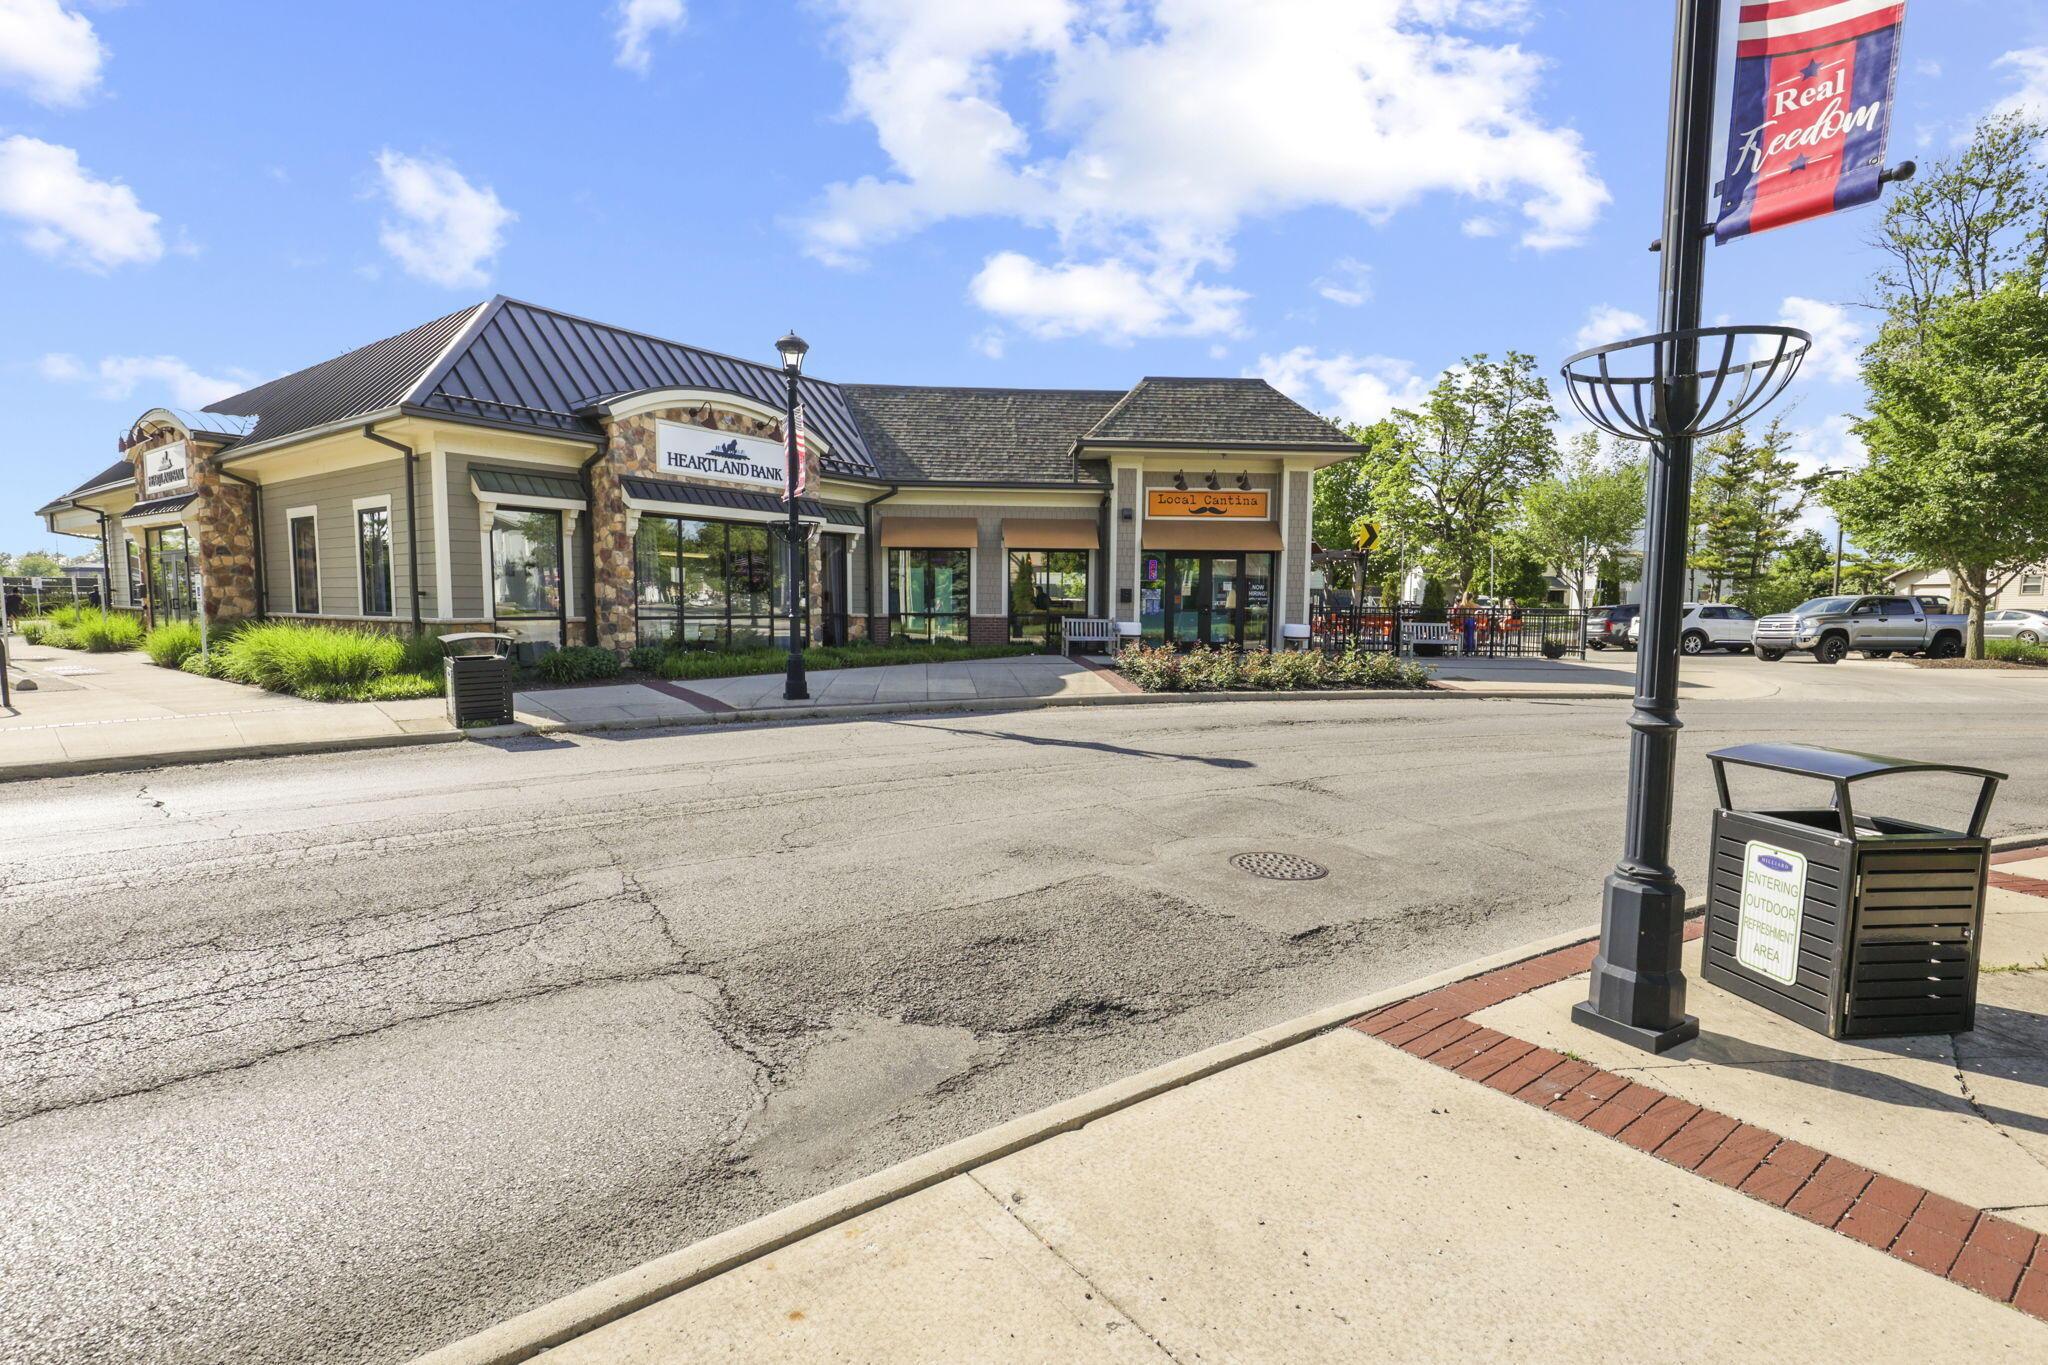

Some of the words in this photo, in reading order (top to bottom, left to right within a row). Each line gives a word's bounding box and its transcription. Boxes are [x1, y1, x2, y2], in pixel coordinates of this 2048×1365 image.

[1772, 69, 1845, 117] Real
[1731, 97, 1880, 175] Freedom
[667, 452, 749, 476] HEARTLAND
[751, 464, 783, 481] BANK
[1158, 494, 1196, 505] Local
[1204, 495, 1258, 506] Cantina
[1748, 871, 1798, 897] ENTERING
[1745, 893, 1796, 921] OUTDOOR
[1743, 916, 1794, 944] REFRESHMENT
[1753, 943, 1780, 963] AREA
